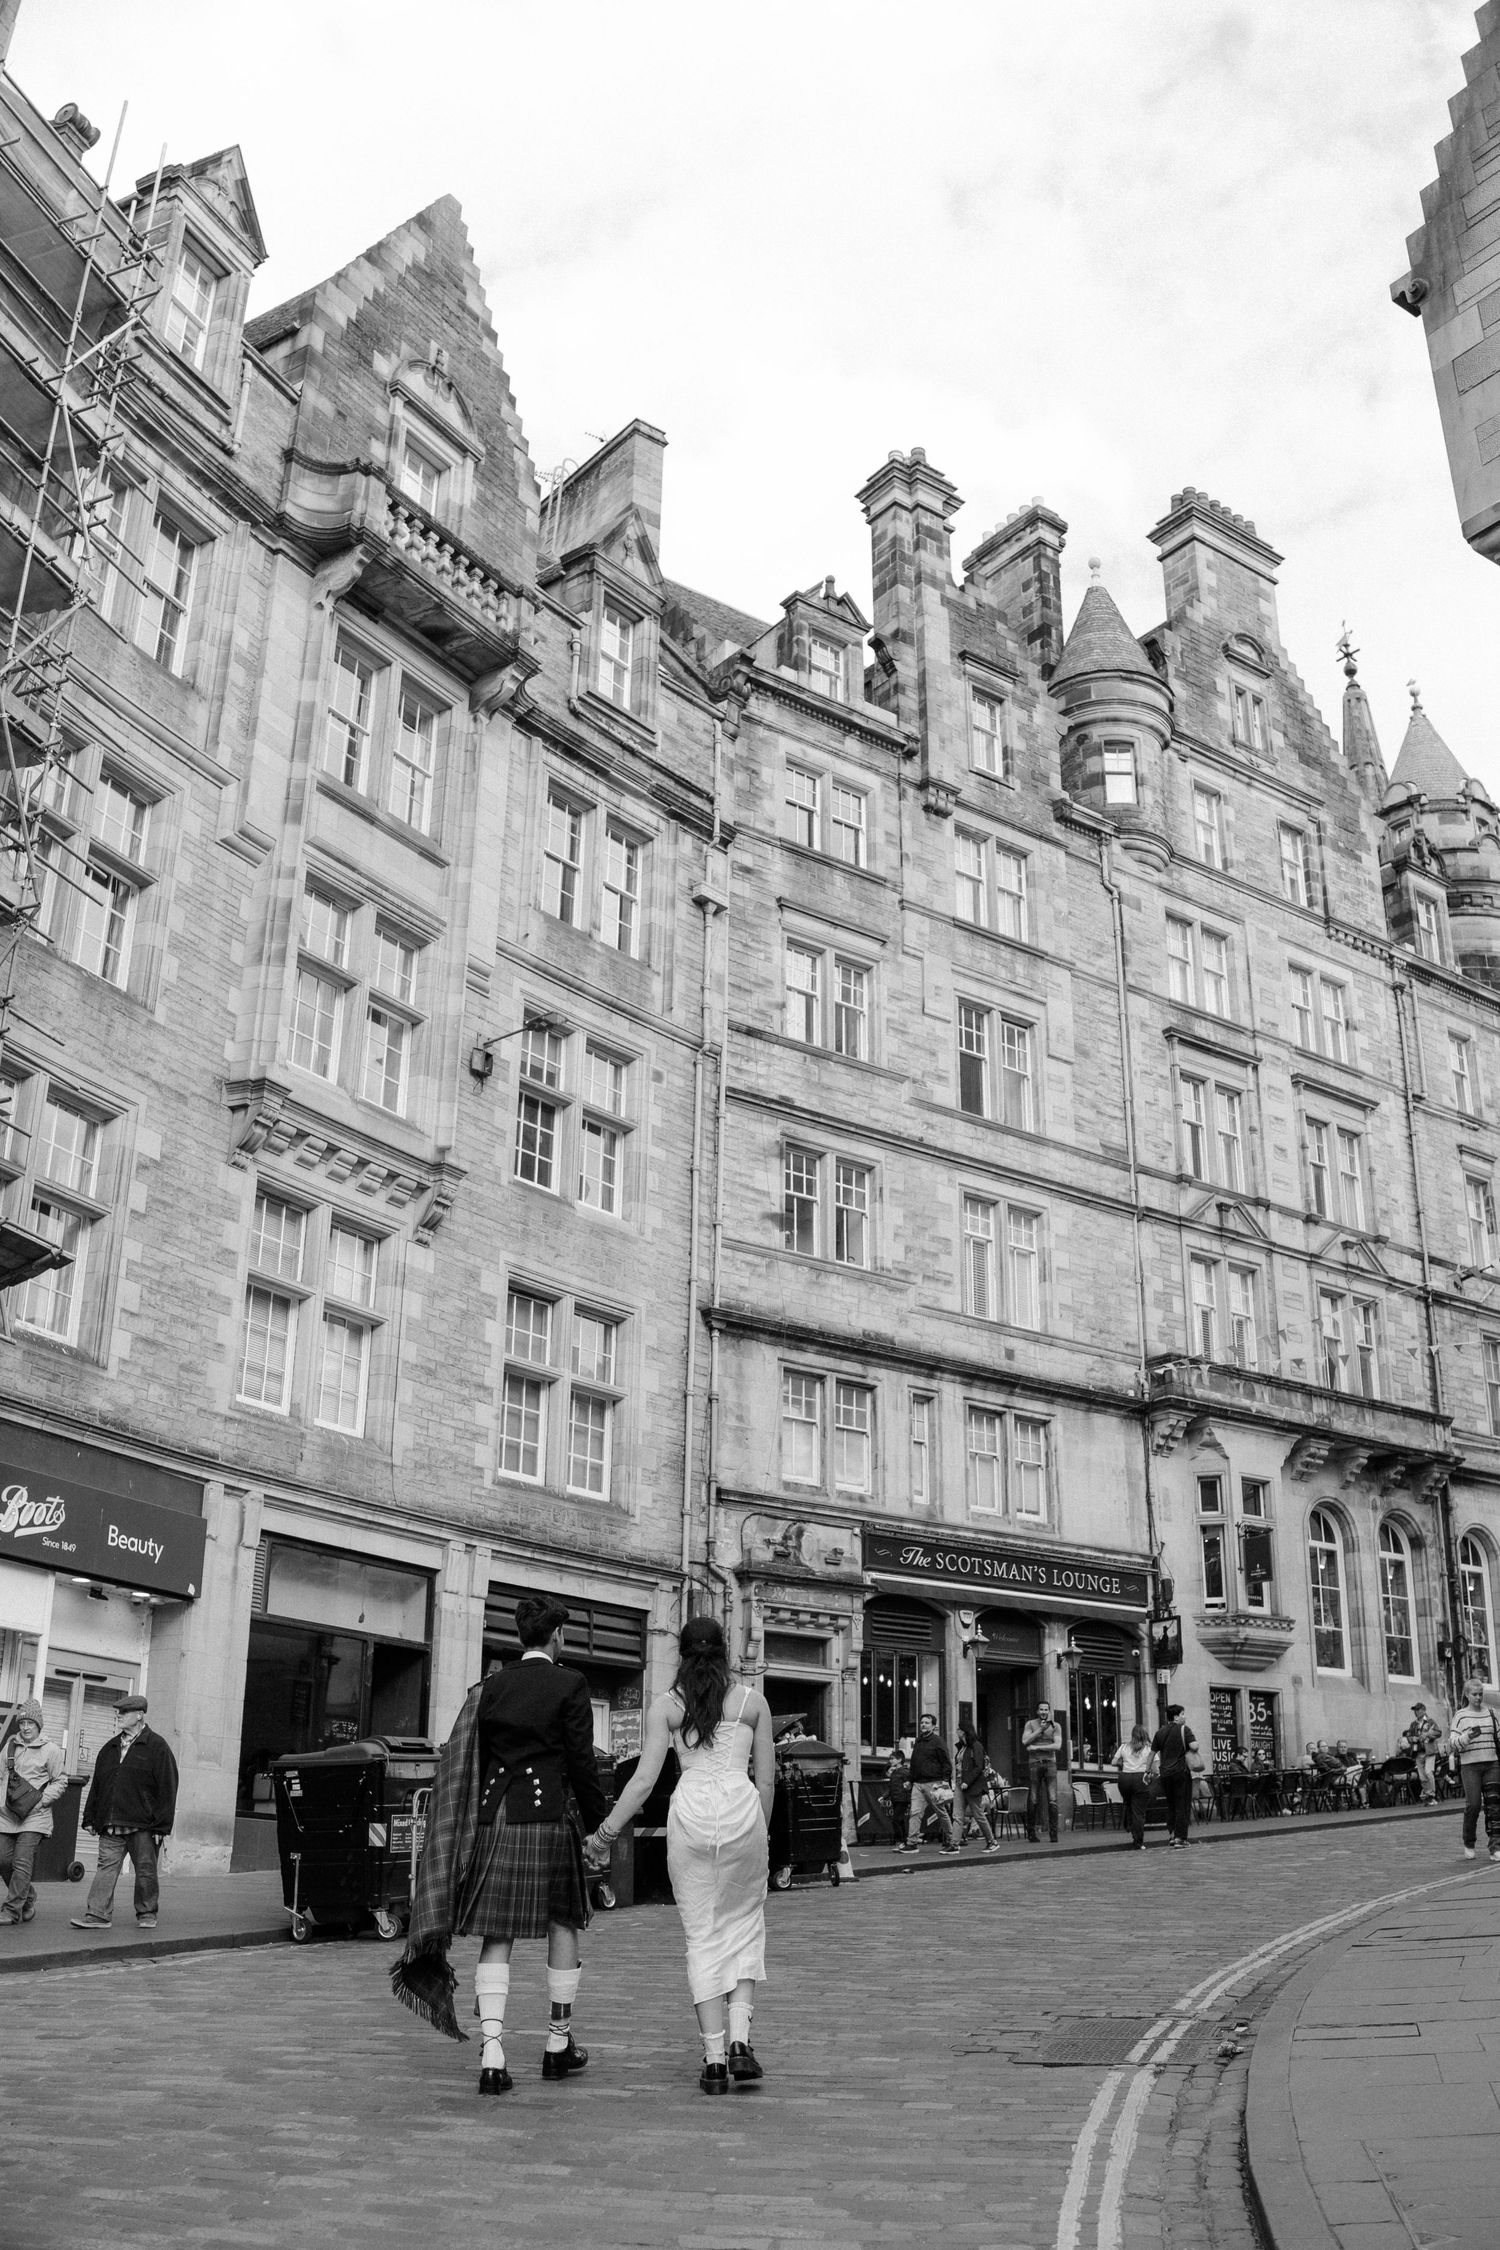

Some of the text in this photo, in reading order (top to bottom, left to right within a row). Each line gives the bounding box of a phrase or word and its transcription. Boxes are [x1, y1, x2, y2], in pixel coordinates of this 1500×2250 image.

[0, 1485, 66, 1538] Boots
[42, 1536, 77, 1552] Since 1849
[107, 1524, 164, 1564] Beauty
[900, 1547, 1121, 1593] The SCOTSMAN'S LOUNGE
[1210, 1692, 1231, 1703] OPEN
[1212, 1739, 1232, 1750] LIVE
